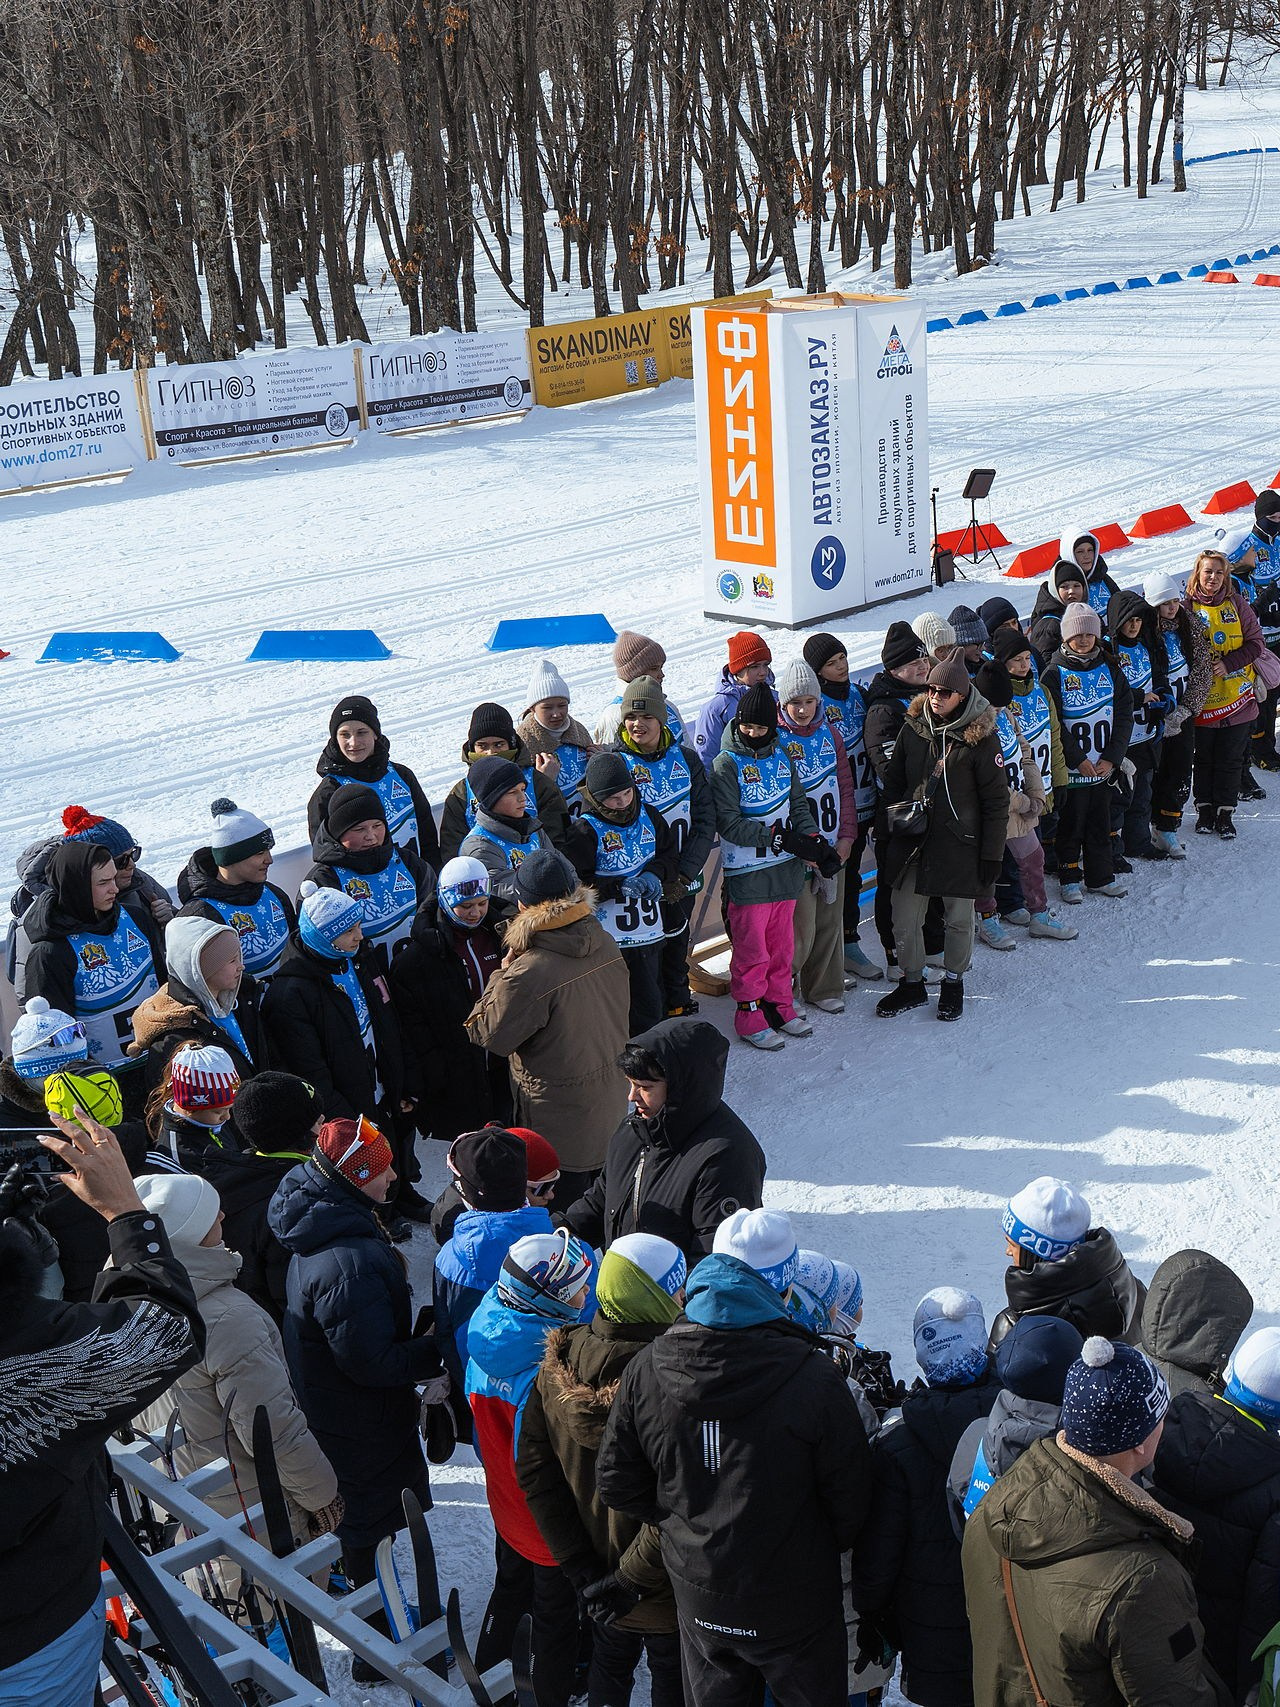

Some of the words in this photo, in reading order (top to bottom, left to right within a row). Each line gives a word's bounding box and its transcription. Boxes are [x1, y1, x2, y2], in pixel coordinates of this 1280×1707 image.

[457, 337, 474, 345] Массаж
[269, 360, 290, 368] Массаж
[539, 363, 565, 375] магазин
[566, 357, 590, 370] беговой
[597, 352, 622, 365] лыжной
[880, 353, 910, 368] МЕГА
[269, 367, 314, 378] Парикмахерские
[314, 365, 333, 374] услуги
[270, 376, 298, 386] Ногтевой
[299, 375, 315, 384] сервис
[461, 376, 480, 384] Солярий
[877, 363, 913, 379] СТРОЙ
[272, 385, 285, 394] Уход
[292, 384, 315, 393] бровями
[320, 380, 349, 390] ресницами
[371, 379, 406, 390] СТУДИЯ
[411, 374, 448, 385] КРАСОТЫ
[272, 393, 313, 404] Перманентный
[313, 390, 332, 399] макияж
[374, 403, 394, 414] Спорт
[399, 398, 424, 409] Красота
[430, 395, 445, 405] Твой
[444, 391, 476, 403] идеальный
[476, 387, 498, 397] баланс!
[69, 405, 124, 428] ЗДАНИЙ
[161, 406, 203, 418] СТУДИЯ
[210, 401, 257, 412] КРАСОТЫ
[273, 403, 297, 412] Солярий
[165, 431, 189, 443] Спорт
[195, 427, 226, 438] Красота
[233, 423, 251, 434] Твой
[252, 418, 292, 431] идеальный
[292, 414, 318, 426] баланс!
[717, 316, 765, 547] ФИНИШ
[807, 336, 833, 526] АВТОЗАКАЗ.РУ
[904, 394, 914, 451] объектов
[2, 431, 73, 450] СПОРТИВНЫХ
[75, 423, 127, 440] ОБЪЕКТОВ
[221, 438, 263, 450] Волочаевская,
[889, 418, 901, 465] зданий
[1, 443, 103, 469] www.dom27.ru
[878, 438, 889, 525] Производство
[906, 455, 917, 528] спортивных
[893, 468, 904, 537] модульных
[908, 531, 917, 555] для
[874, 568, 924, 588] www.dom27.ru
[1071, 719, 1111, 755] 80
[927, 1334, 963, 1350] ALEXANDER
[974, 1479, 990, 1492] АНО
[694, 1617, 757, 1637] NORDSKI
